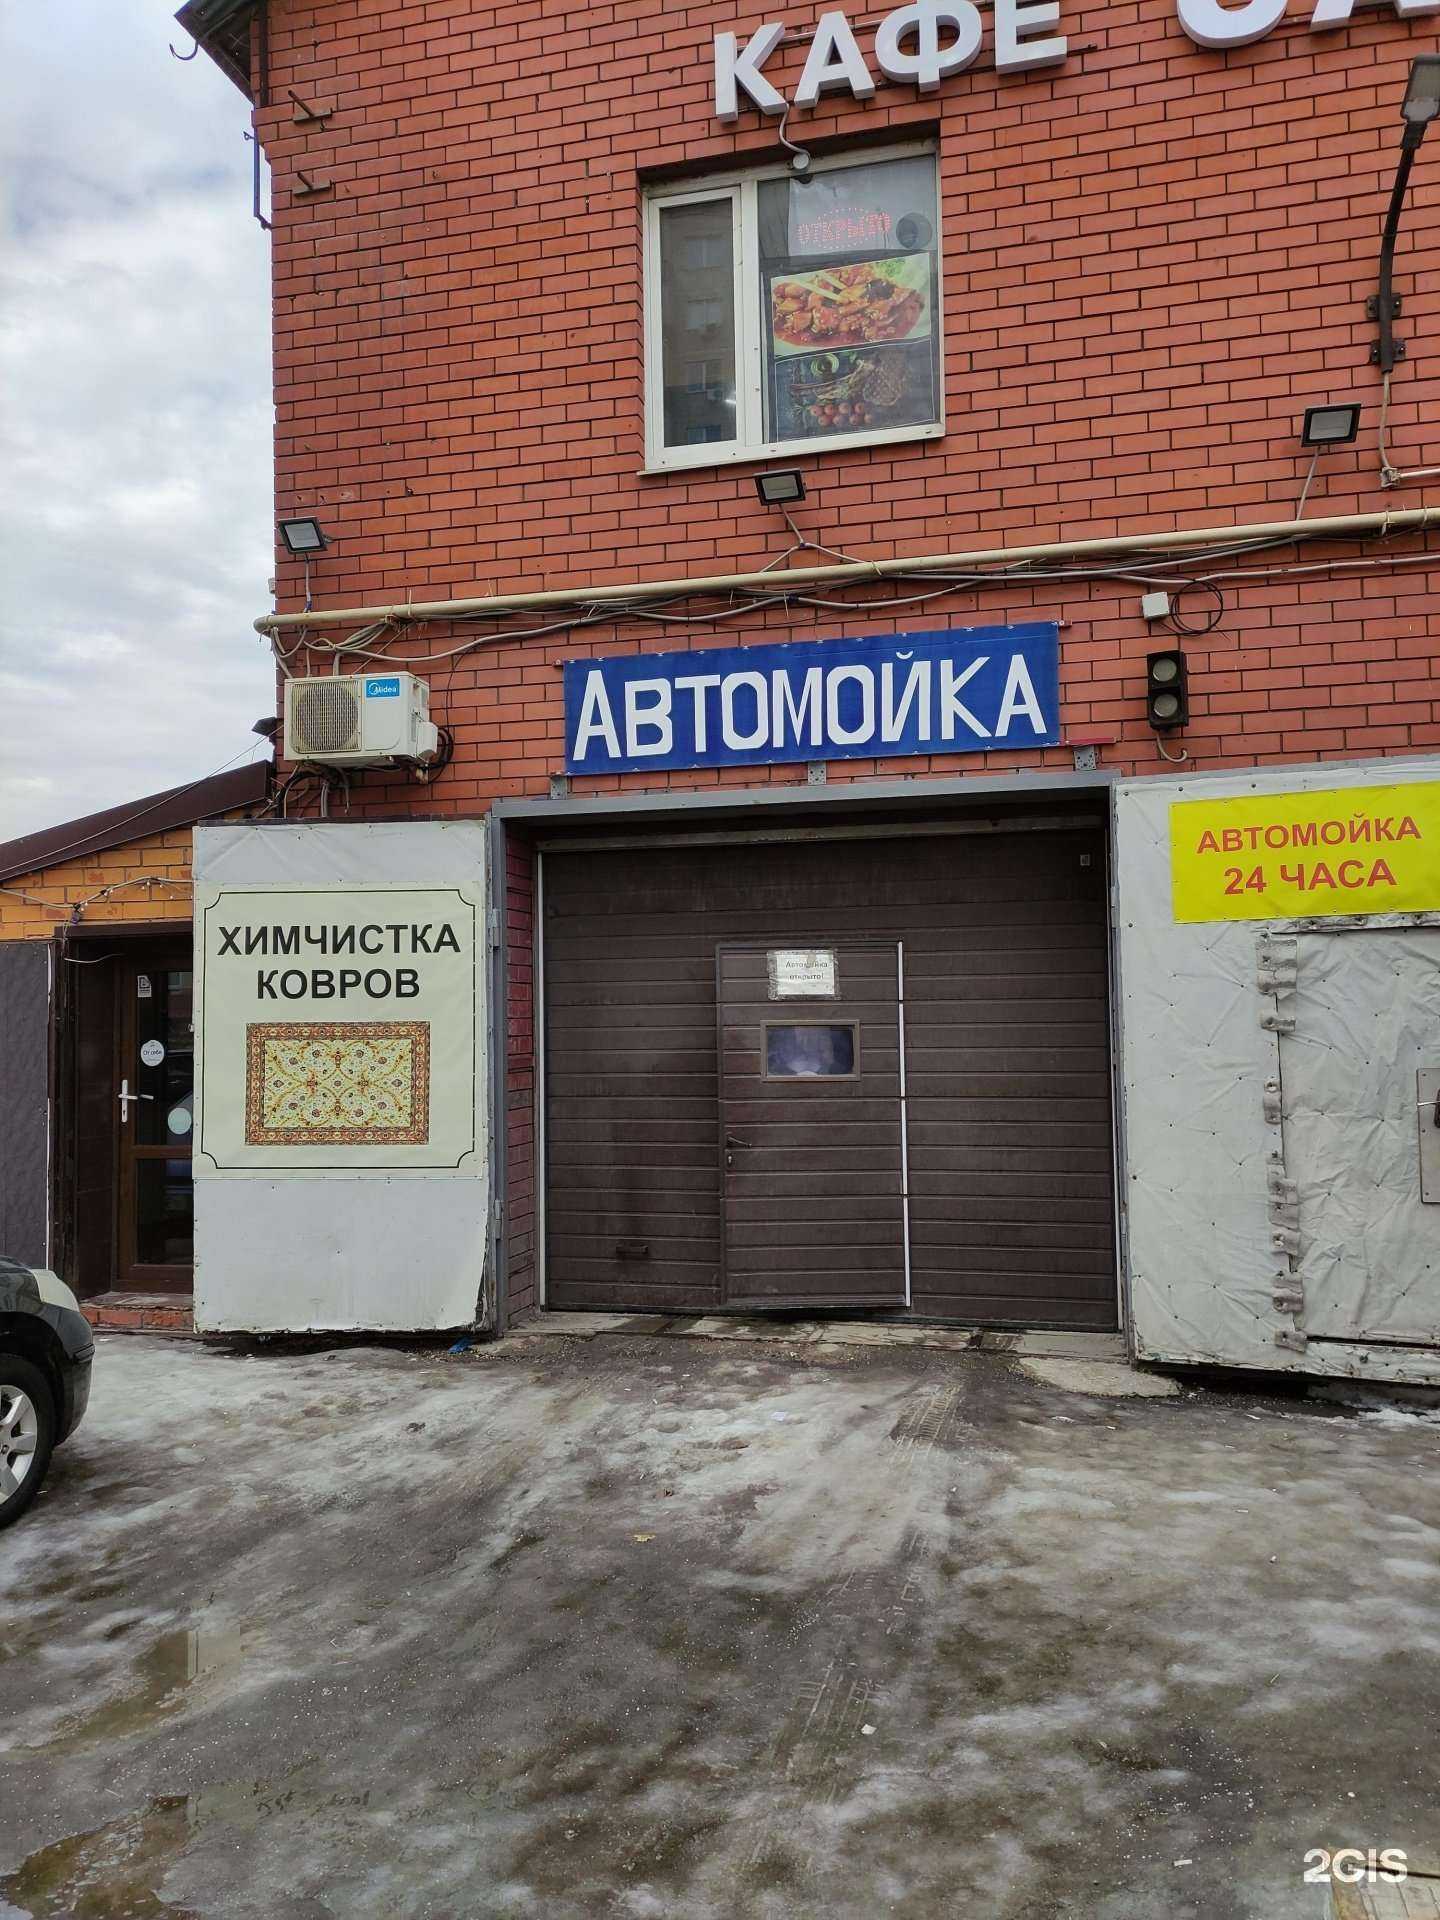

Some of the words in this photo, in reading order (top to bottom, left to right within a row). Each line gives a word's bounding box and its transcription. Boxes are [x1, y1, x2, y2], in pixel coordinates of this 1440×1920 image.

[714, 0, 1068, 122] КАФЕ
[572, 650, 1048, 761] АВТОМОЙКА
[1196, 812, 1422, 854] АВТОМОЙКА
[1224, 865, 1267, 895] 24
[1280, 858, 1398, 891] ЧАСА
[217, 923, 461, 955] ХИМЧИСТКА
[257, 968, 420, 999] КОВРОВ
